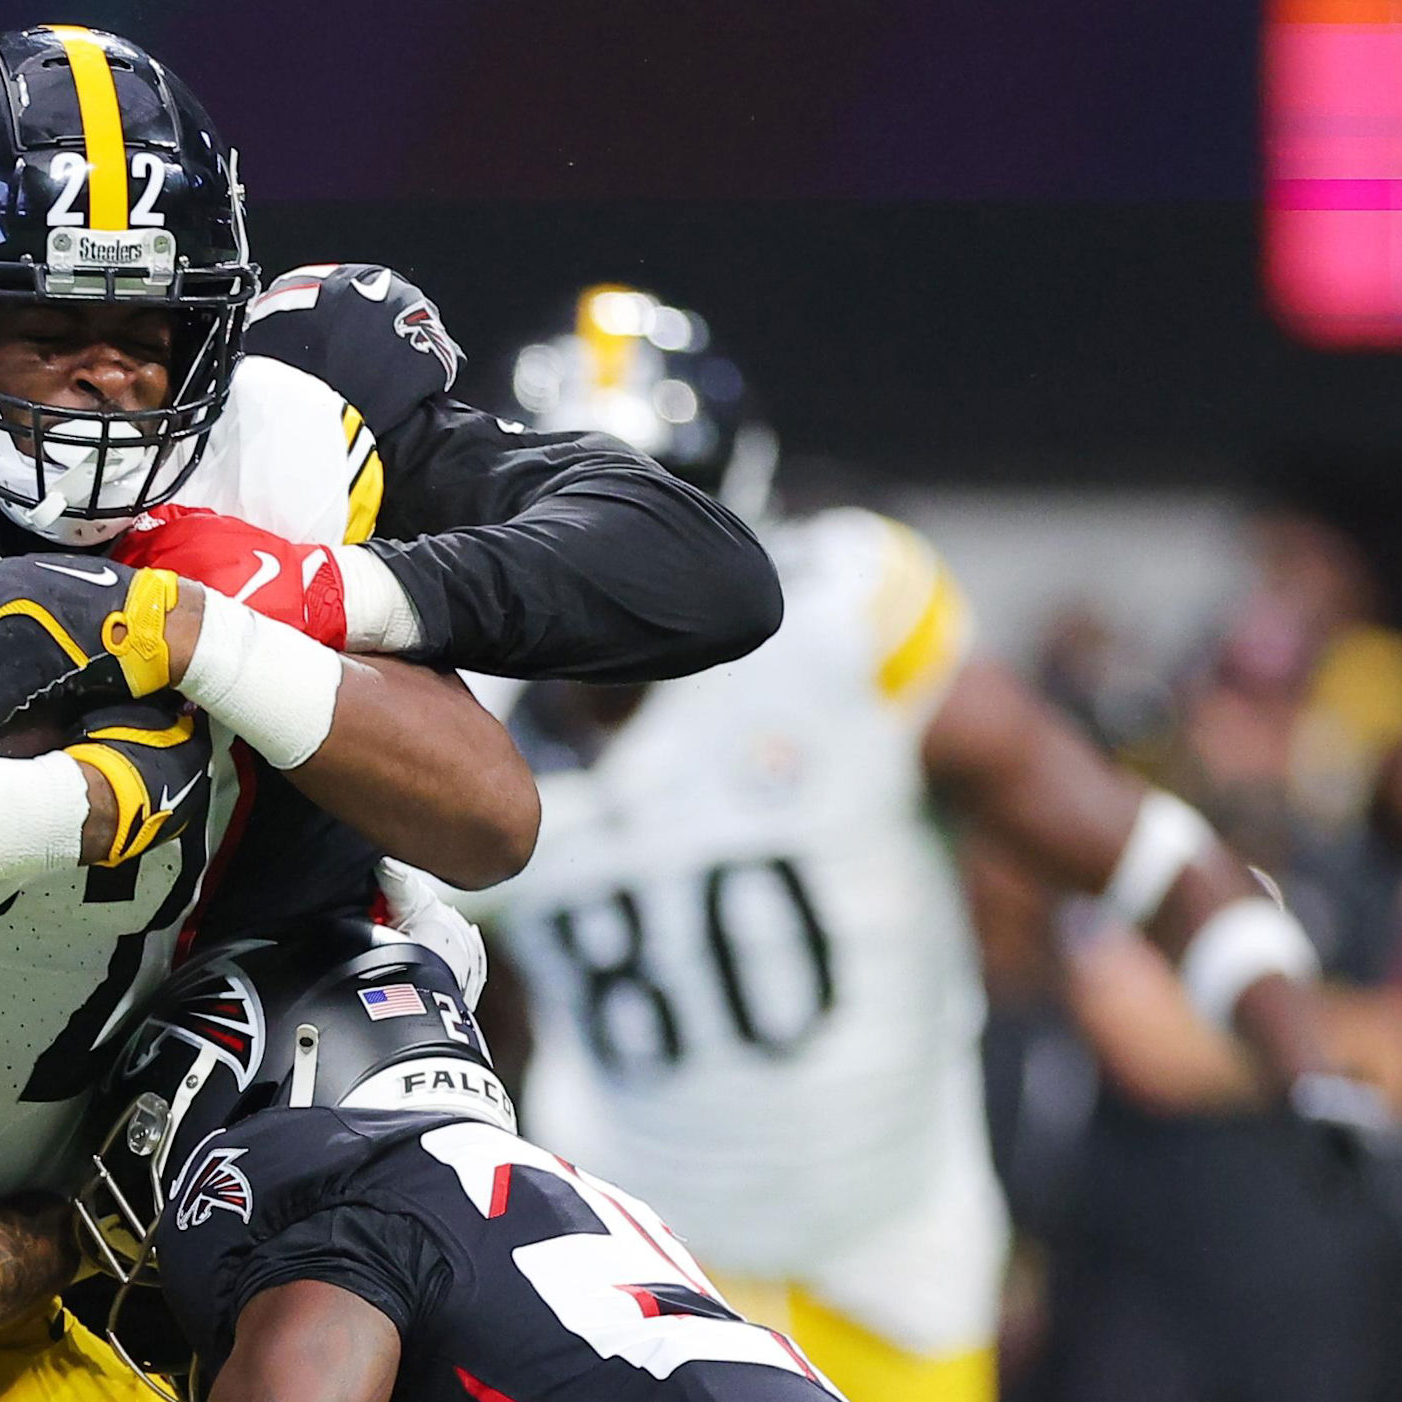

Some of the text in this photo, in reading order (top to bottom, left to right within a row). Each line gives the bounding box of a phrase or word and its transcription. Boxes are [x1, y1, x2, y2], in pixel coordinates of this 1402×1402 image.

[47, 152, 165, 226] 22
[79, 236, 143, 263] Steelers
[550, 856, 836, 1074] 80
